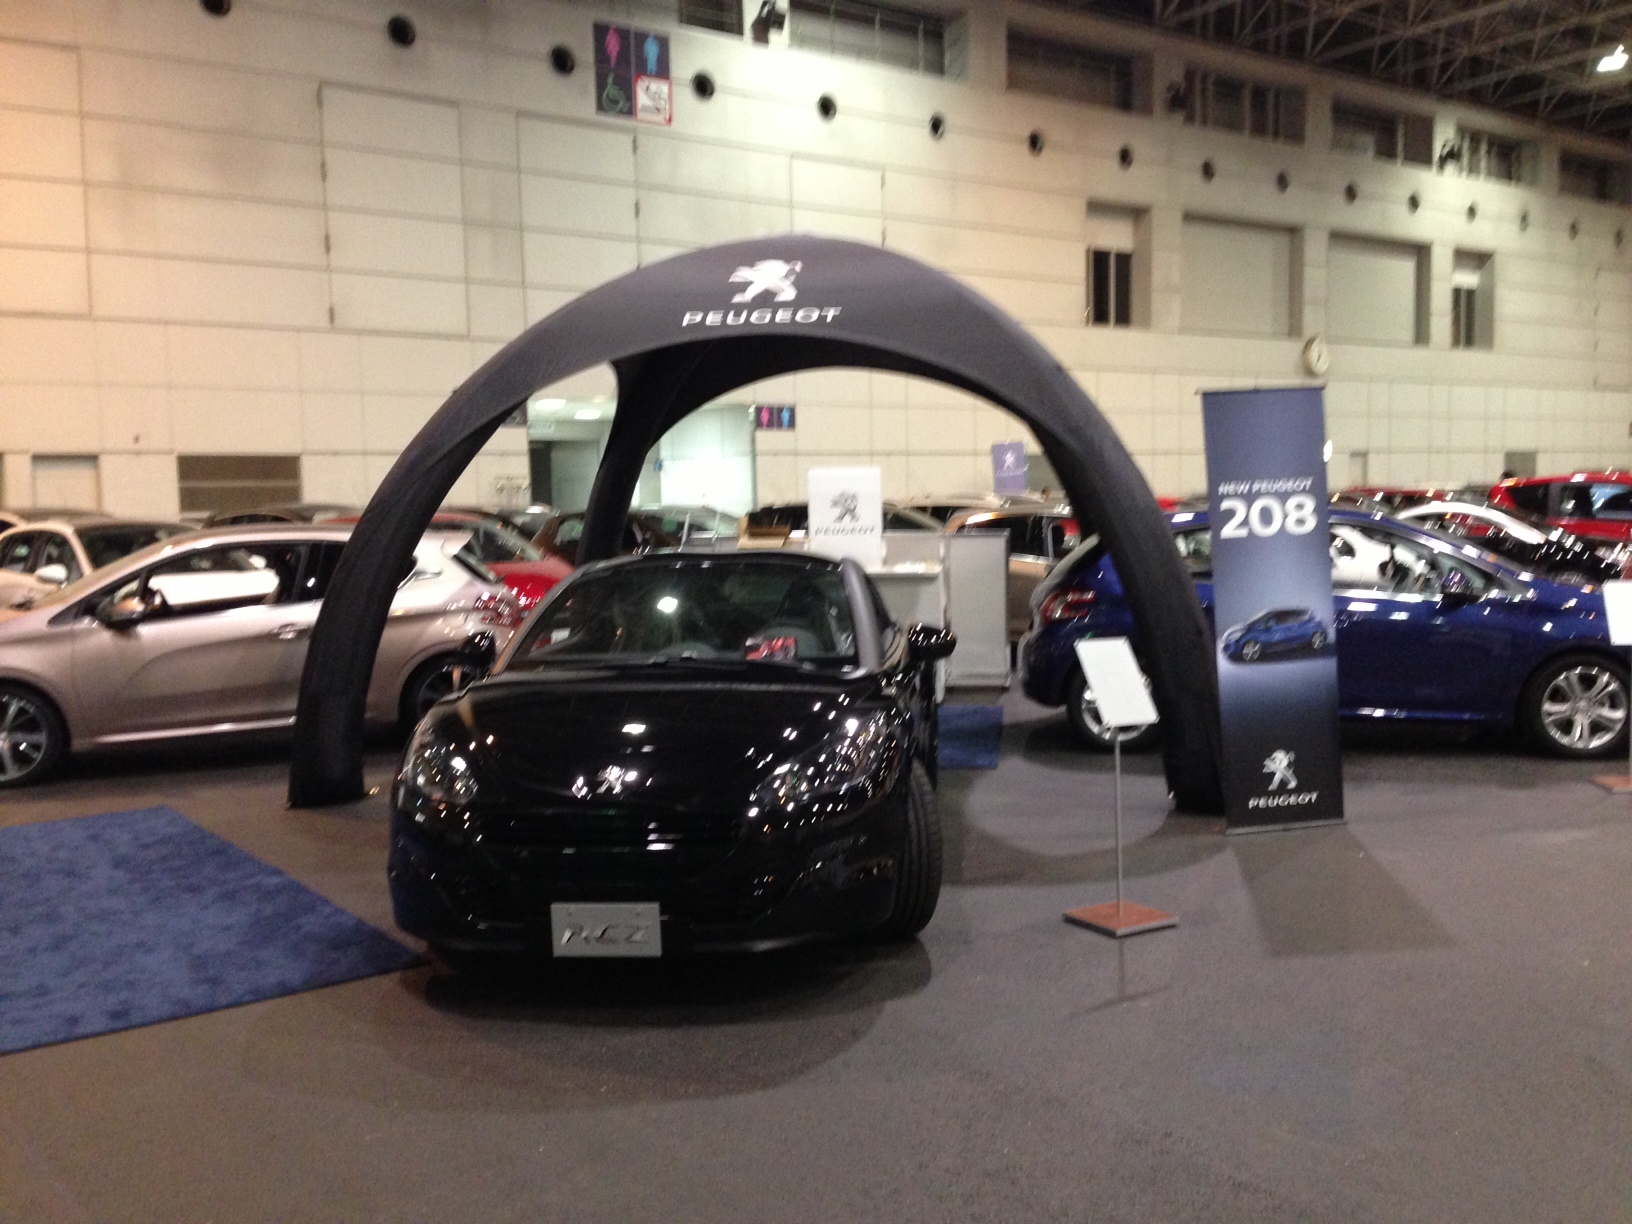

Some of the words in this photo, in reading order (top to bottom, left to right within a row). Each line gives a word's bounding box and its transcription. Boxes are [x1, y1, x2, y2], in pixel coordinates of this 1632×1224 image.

[682, 306, 842, 327] PEUGEOT
[1218, 480, 1251, 495] NEW
[1252, 477, 1314, 493] PEUGEOT
[1220, 494, 1318, 539] 208
[1248, 791, 1319, 809] PEUGEOT
